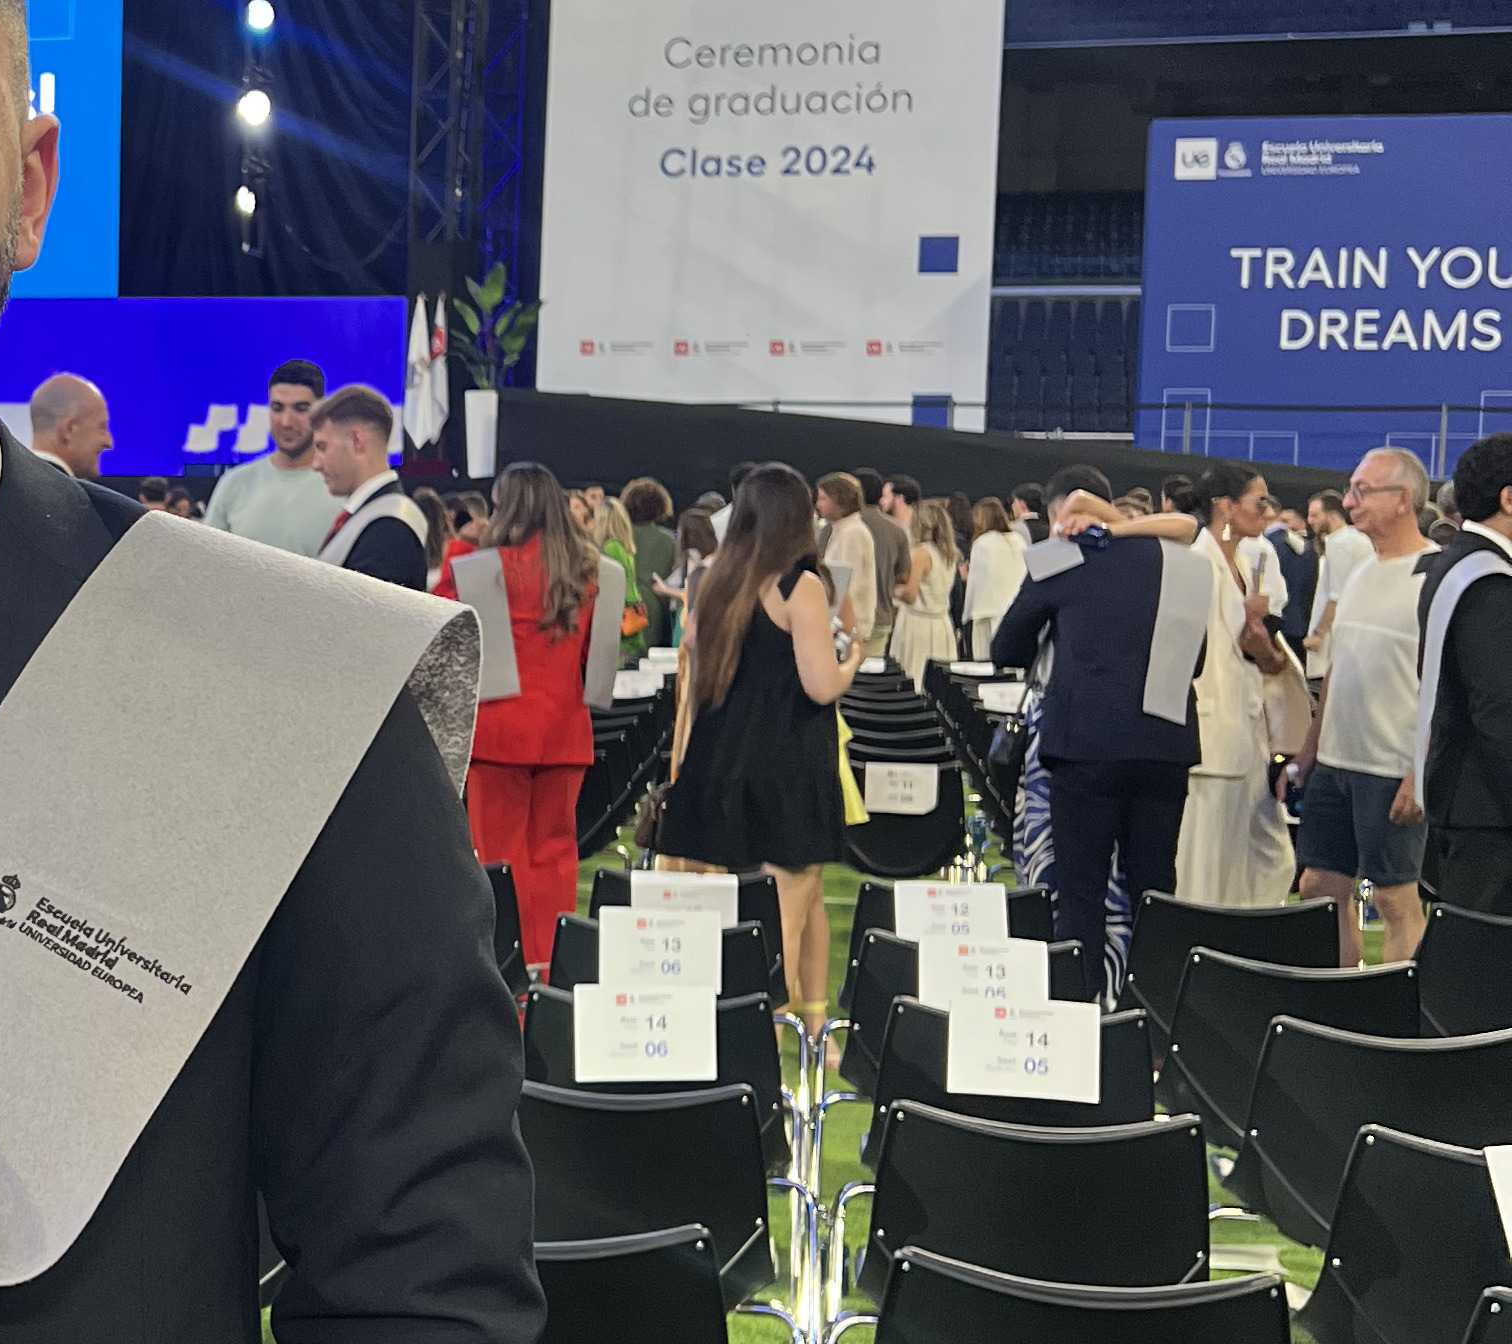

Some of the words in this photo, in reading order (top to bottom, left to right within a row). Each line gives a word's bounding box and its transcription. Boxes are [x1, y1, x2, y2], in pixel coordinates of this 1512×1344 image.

[663, 33, 881, 69] Ceremonia
[628, 86, 674, 118] de
[688, 82, 914, 125] graduación
[660, 147, 766, 179] Clase
[780, 144, 876, 176] 2024
[1230, 246, 1387, 290] TRAIN
[1279, 309, 1502, 352] DREAMS
[26, 909, 63, 941] Real
[61, 928, 120, 971] Madrid
[35, 896, 95, 939] Escuela
[94, 928, 192, 996] Universitaria
[662, 937, 682, 953] 13
[18, 921, 91, 972] UNIVERSIDAD
[90, 965, 144, 1004] EUROPEA
[661, 959, 681, 975] 06
[986, 963, 1006, 980] 13
[646, 1014, 668, 1032] 14
[1026, 1030, 1049, 1050] 14
[645, 1041, 668, 1058] 06
[1024, 1057, 1049, 1076] 05
